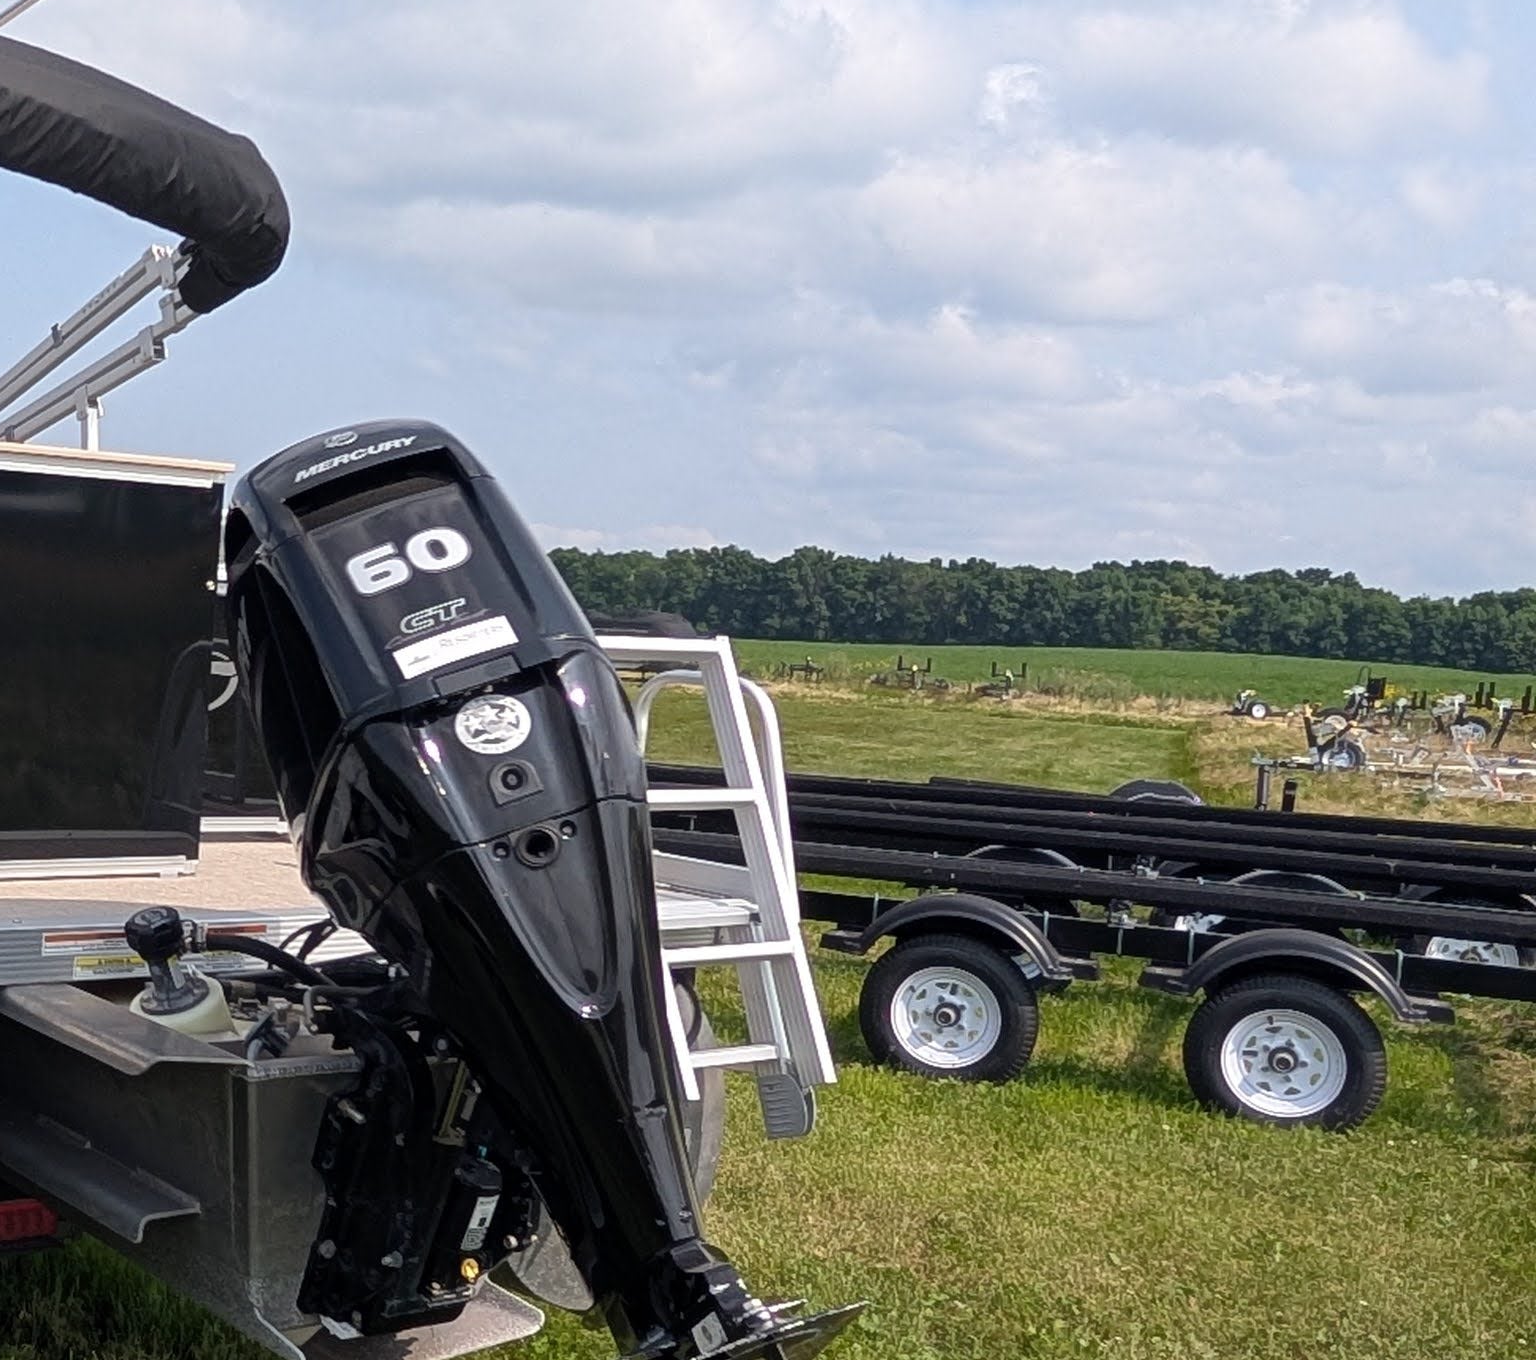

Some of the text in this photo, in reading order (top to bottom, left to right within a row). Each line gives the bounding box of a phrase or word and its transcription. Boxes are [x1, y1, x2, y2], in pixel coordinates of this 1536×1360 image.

[293, 435, 418, 484] MERCURY
[345, 527, 471, 596] 60
[399, 598, 466, 634] GT
